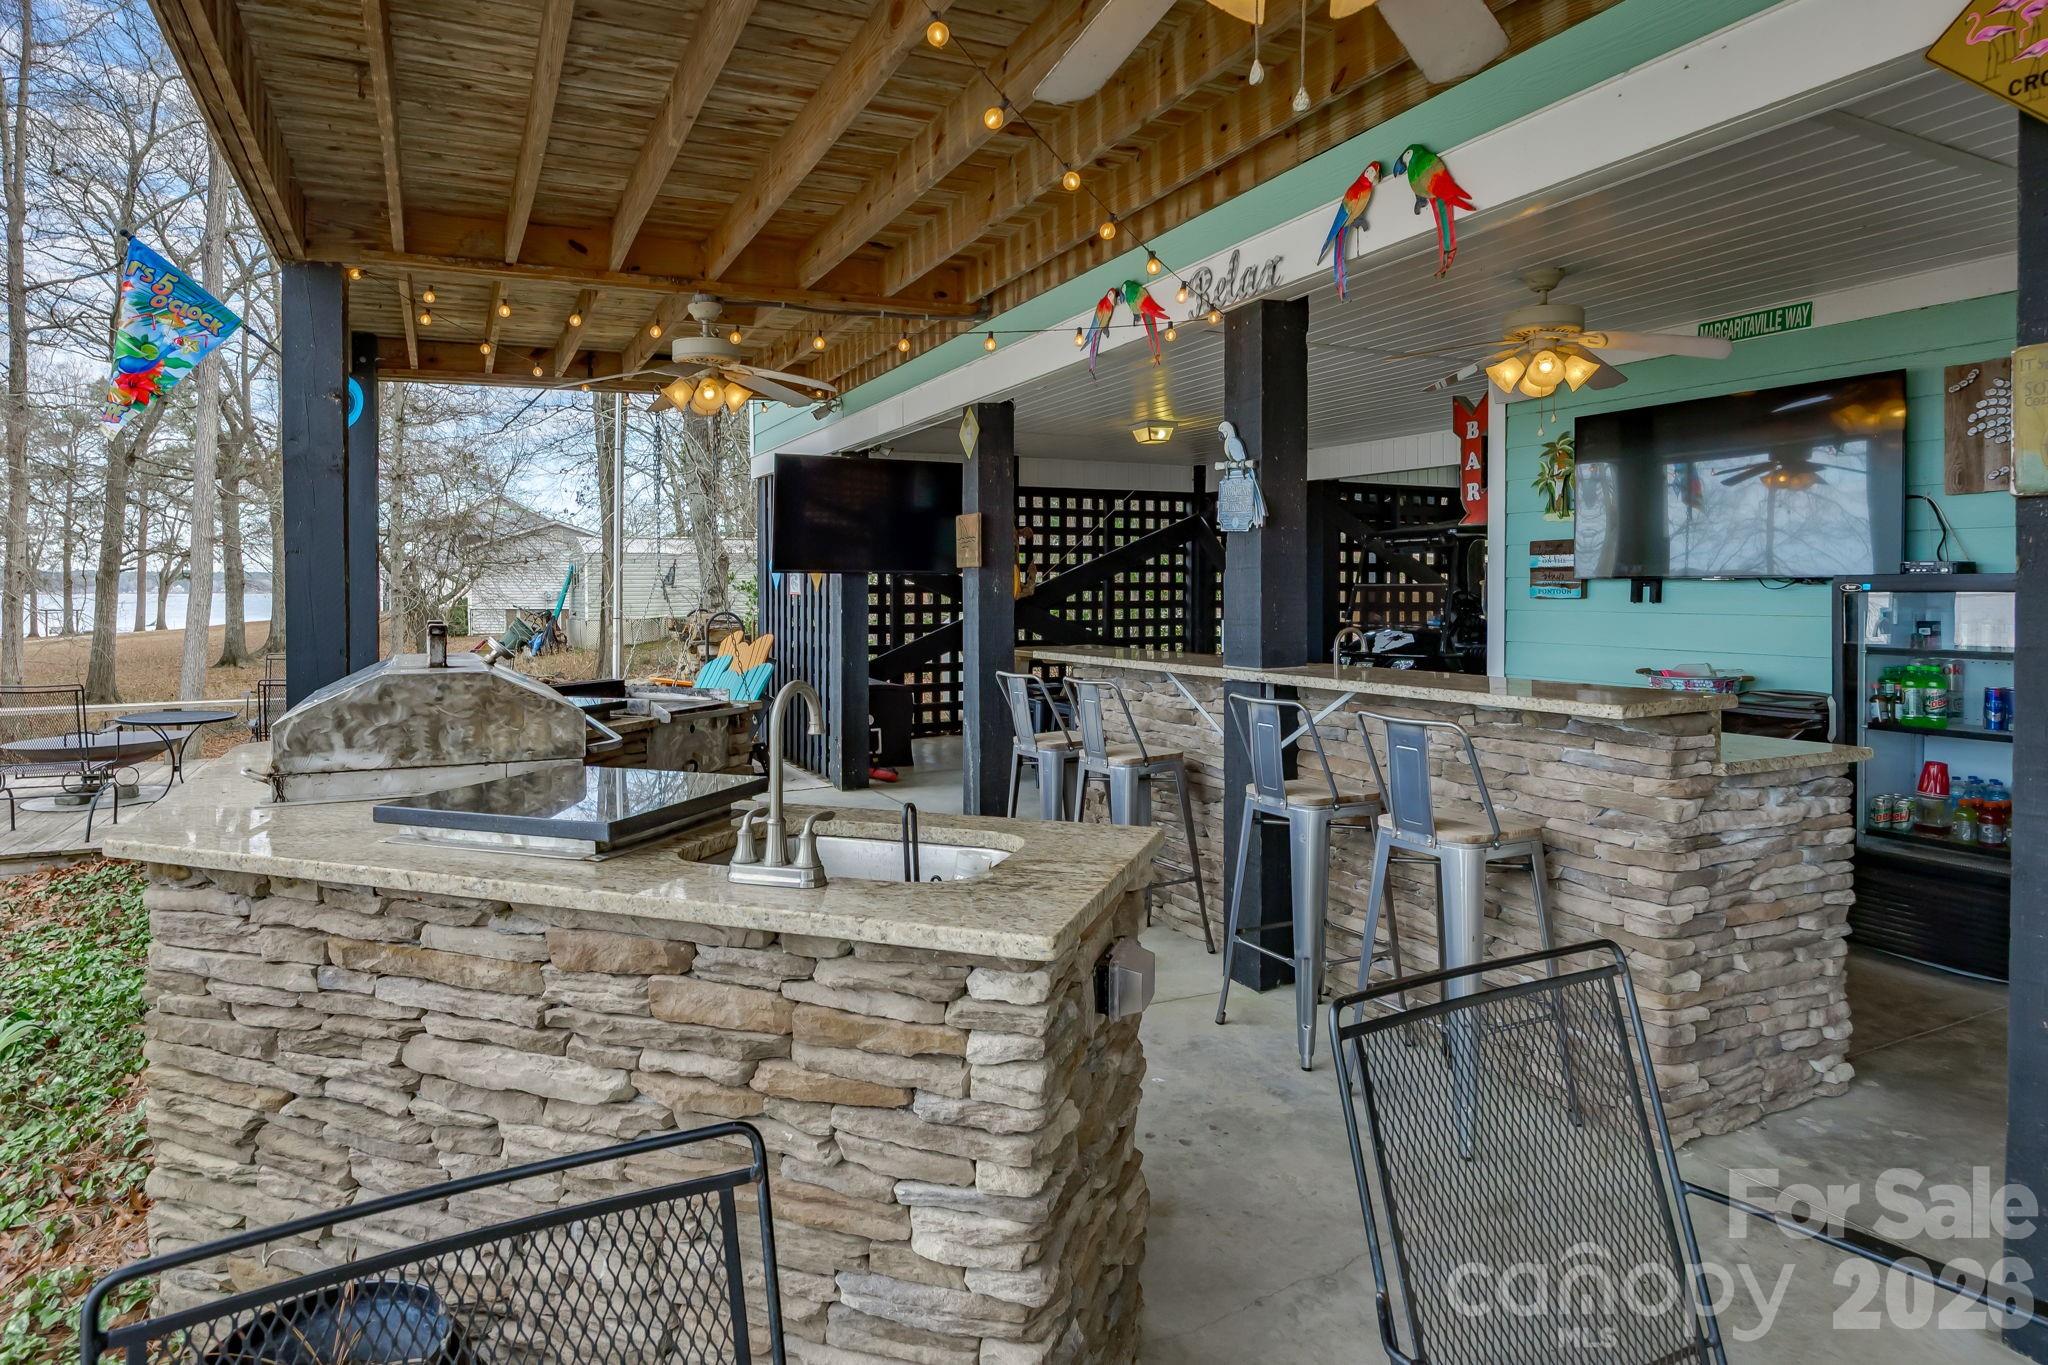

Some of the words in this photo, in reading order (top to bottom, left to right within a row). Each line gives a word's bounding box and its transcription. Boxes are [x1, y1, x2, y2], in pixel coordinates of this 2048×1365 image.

[151, 271, 180, 297] 5
[1188, 249, 1284, 320] Relax
[150, 294, 226, 338] O'CLOCK
[1700, 309, 1782, 339] MARGARITAVILLE
[1786, 304, 1810, 329] WAY
[1465, 420, 1481, 501] BAR
